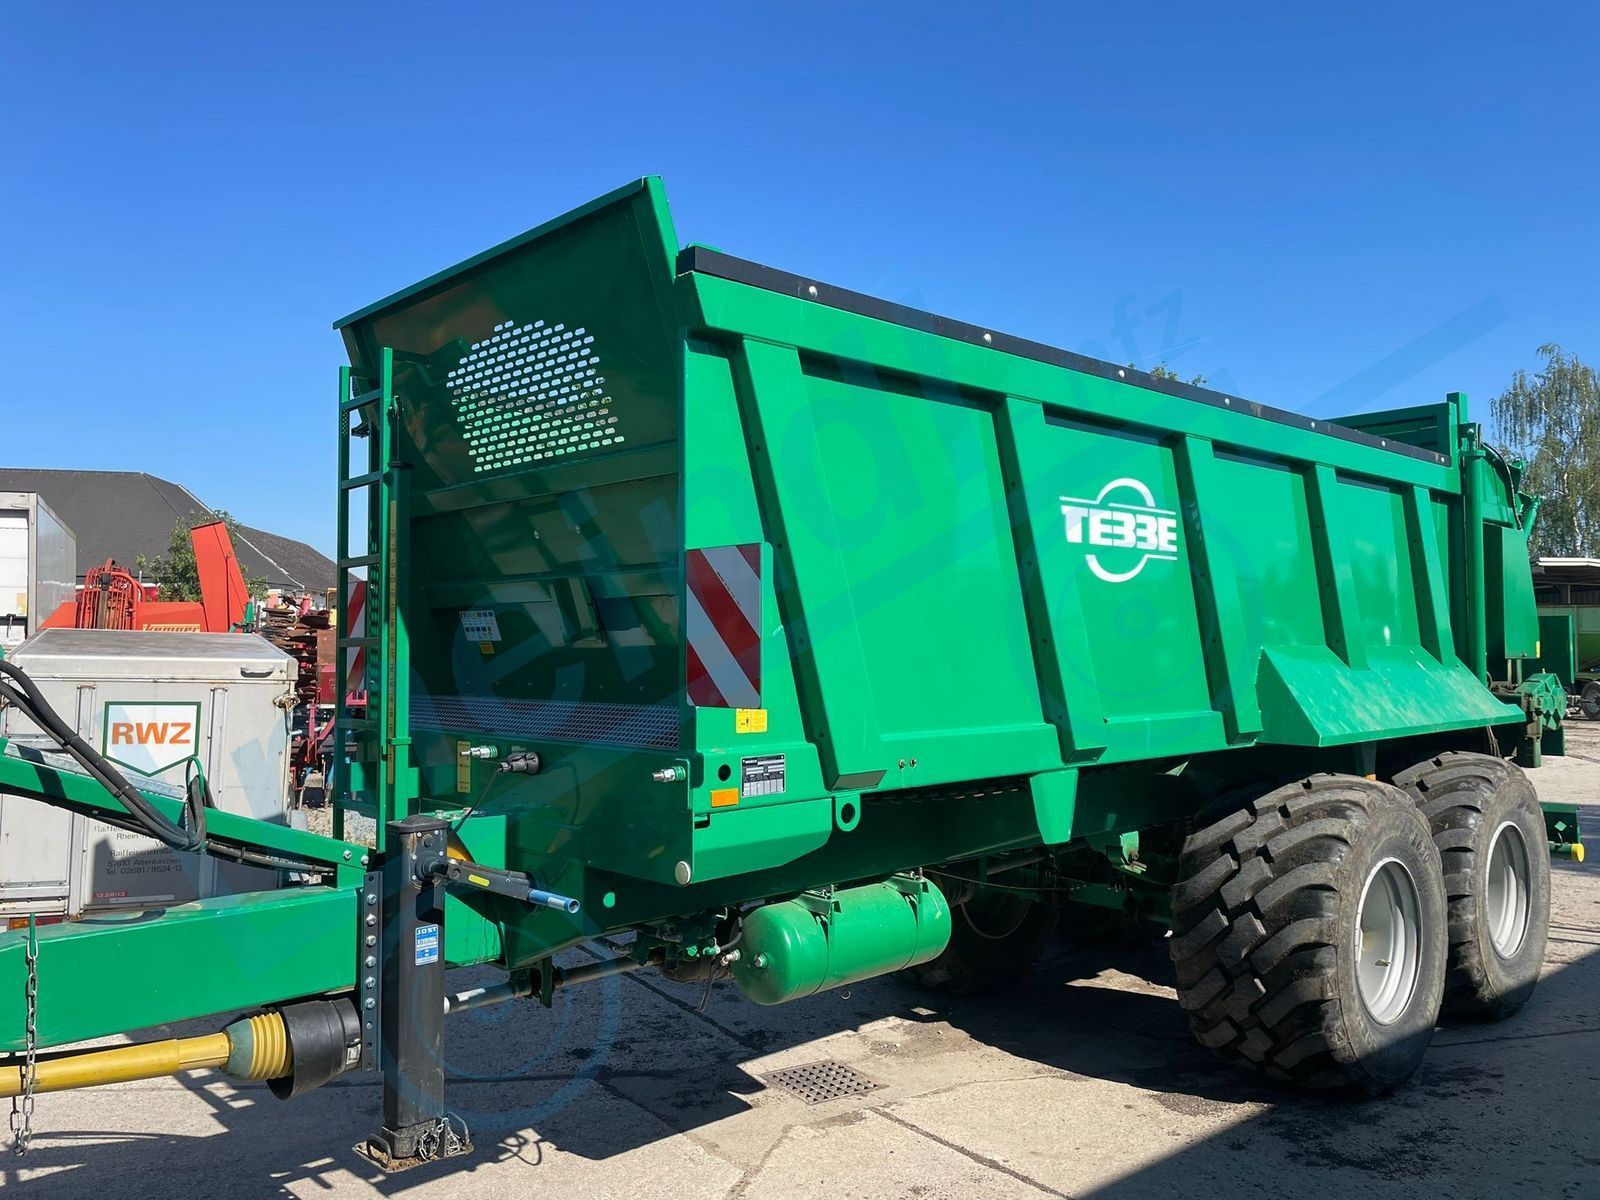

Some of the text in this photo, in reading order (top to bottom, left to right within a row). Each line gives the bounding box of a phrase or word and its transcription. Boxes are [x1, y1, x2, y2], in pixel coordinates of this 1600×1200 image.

[1061, 505, 1177, 552] TEBBE
[112, 722, 191, 744] RWZ
[418, 927, 437, 935] JOST
